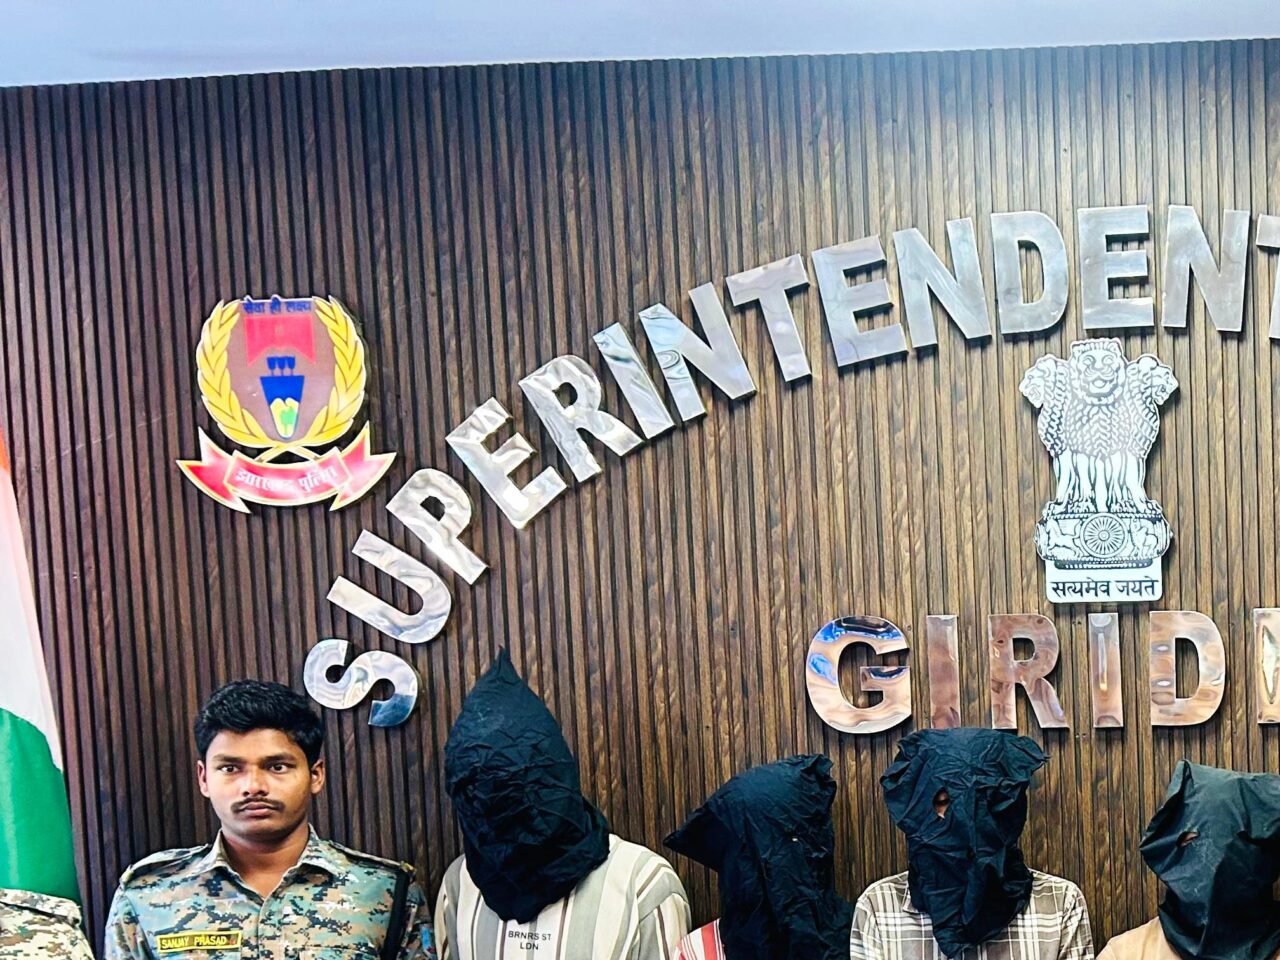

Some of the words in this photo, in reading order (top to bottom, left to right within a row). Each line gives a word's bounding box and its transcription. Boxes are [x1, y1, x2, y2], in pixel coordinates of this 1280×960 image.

[1051, 576, 1112, 598] सत्यमेव
[1115, 575, 1160, 597] जयते
[194, 935, 227, 946] PRASAD
[508, 930, 539, 940] BRNRS
[541, 933, 552, 941] ST
